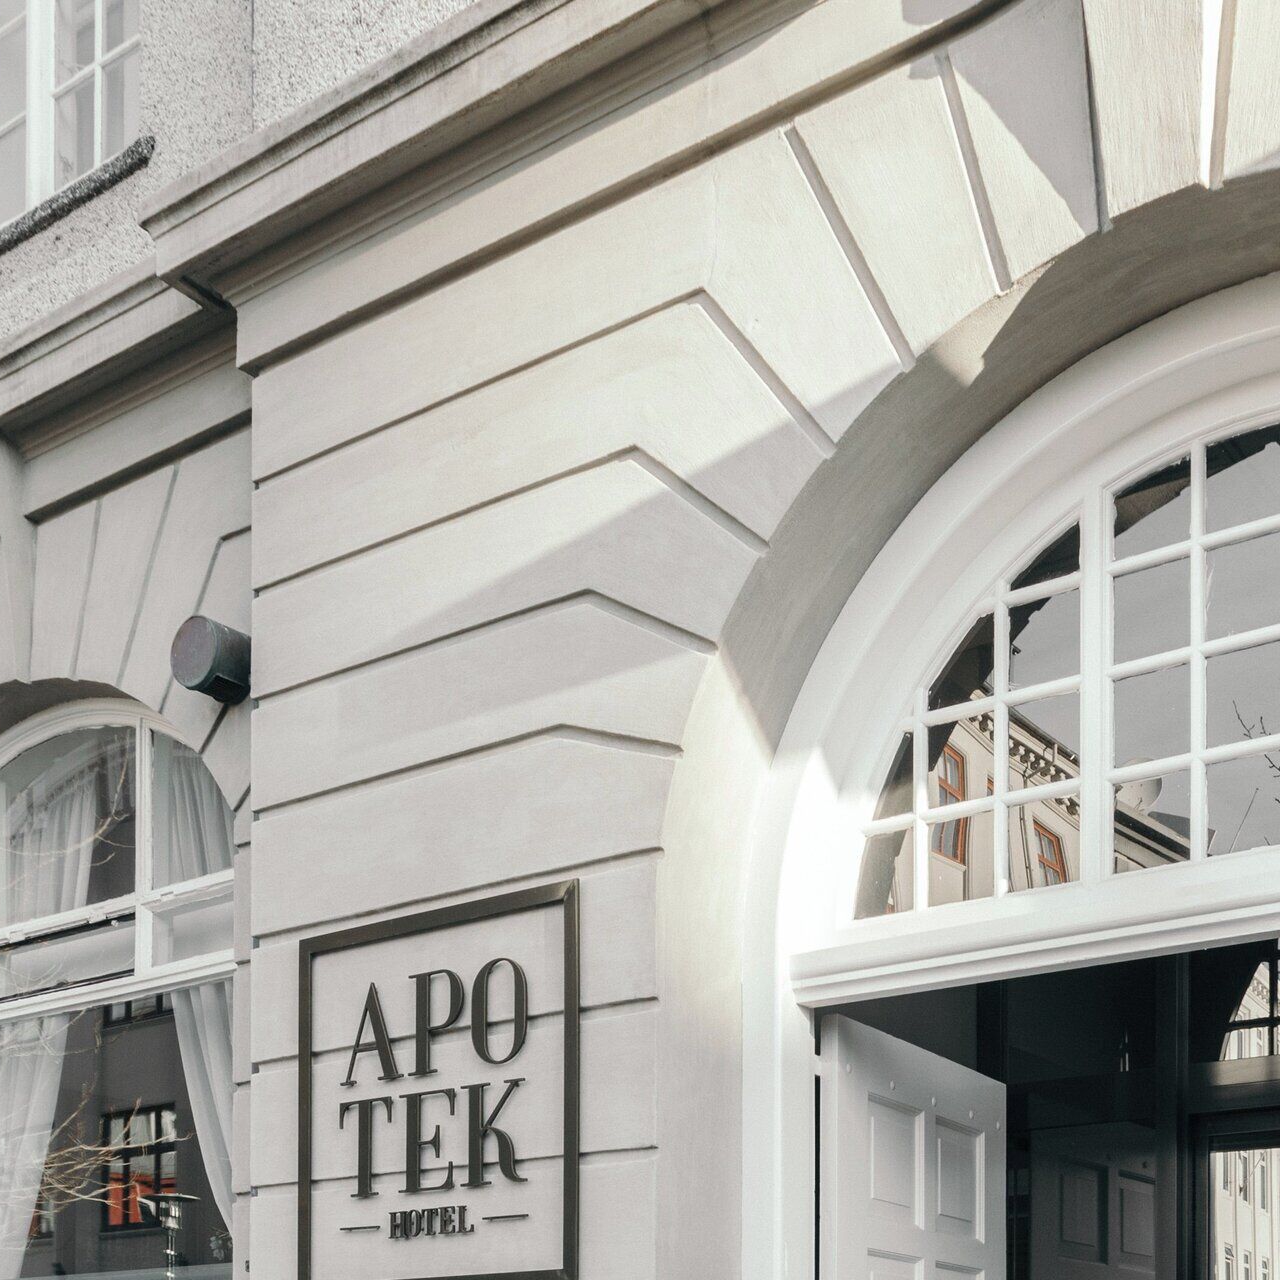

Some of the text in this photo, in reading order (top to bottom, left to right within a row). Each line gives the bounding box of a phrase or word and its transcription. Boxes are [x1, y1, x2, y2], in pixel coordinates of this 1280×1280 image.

[339, 957, 528, 1087] APO
[338, 1077, 528, 1198] TEK
[388, 1205, 475, 1239] HOTEL
